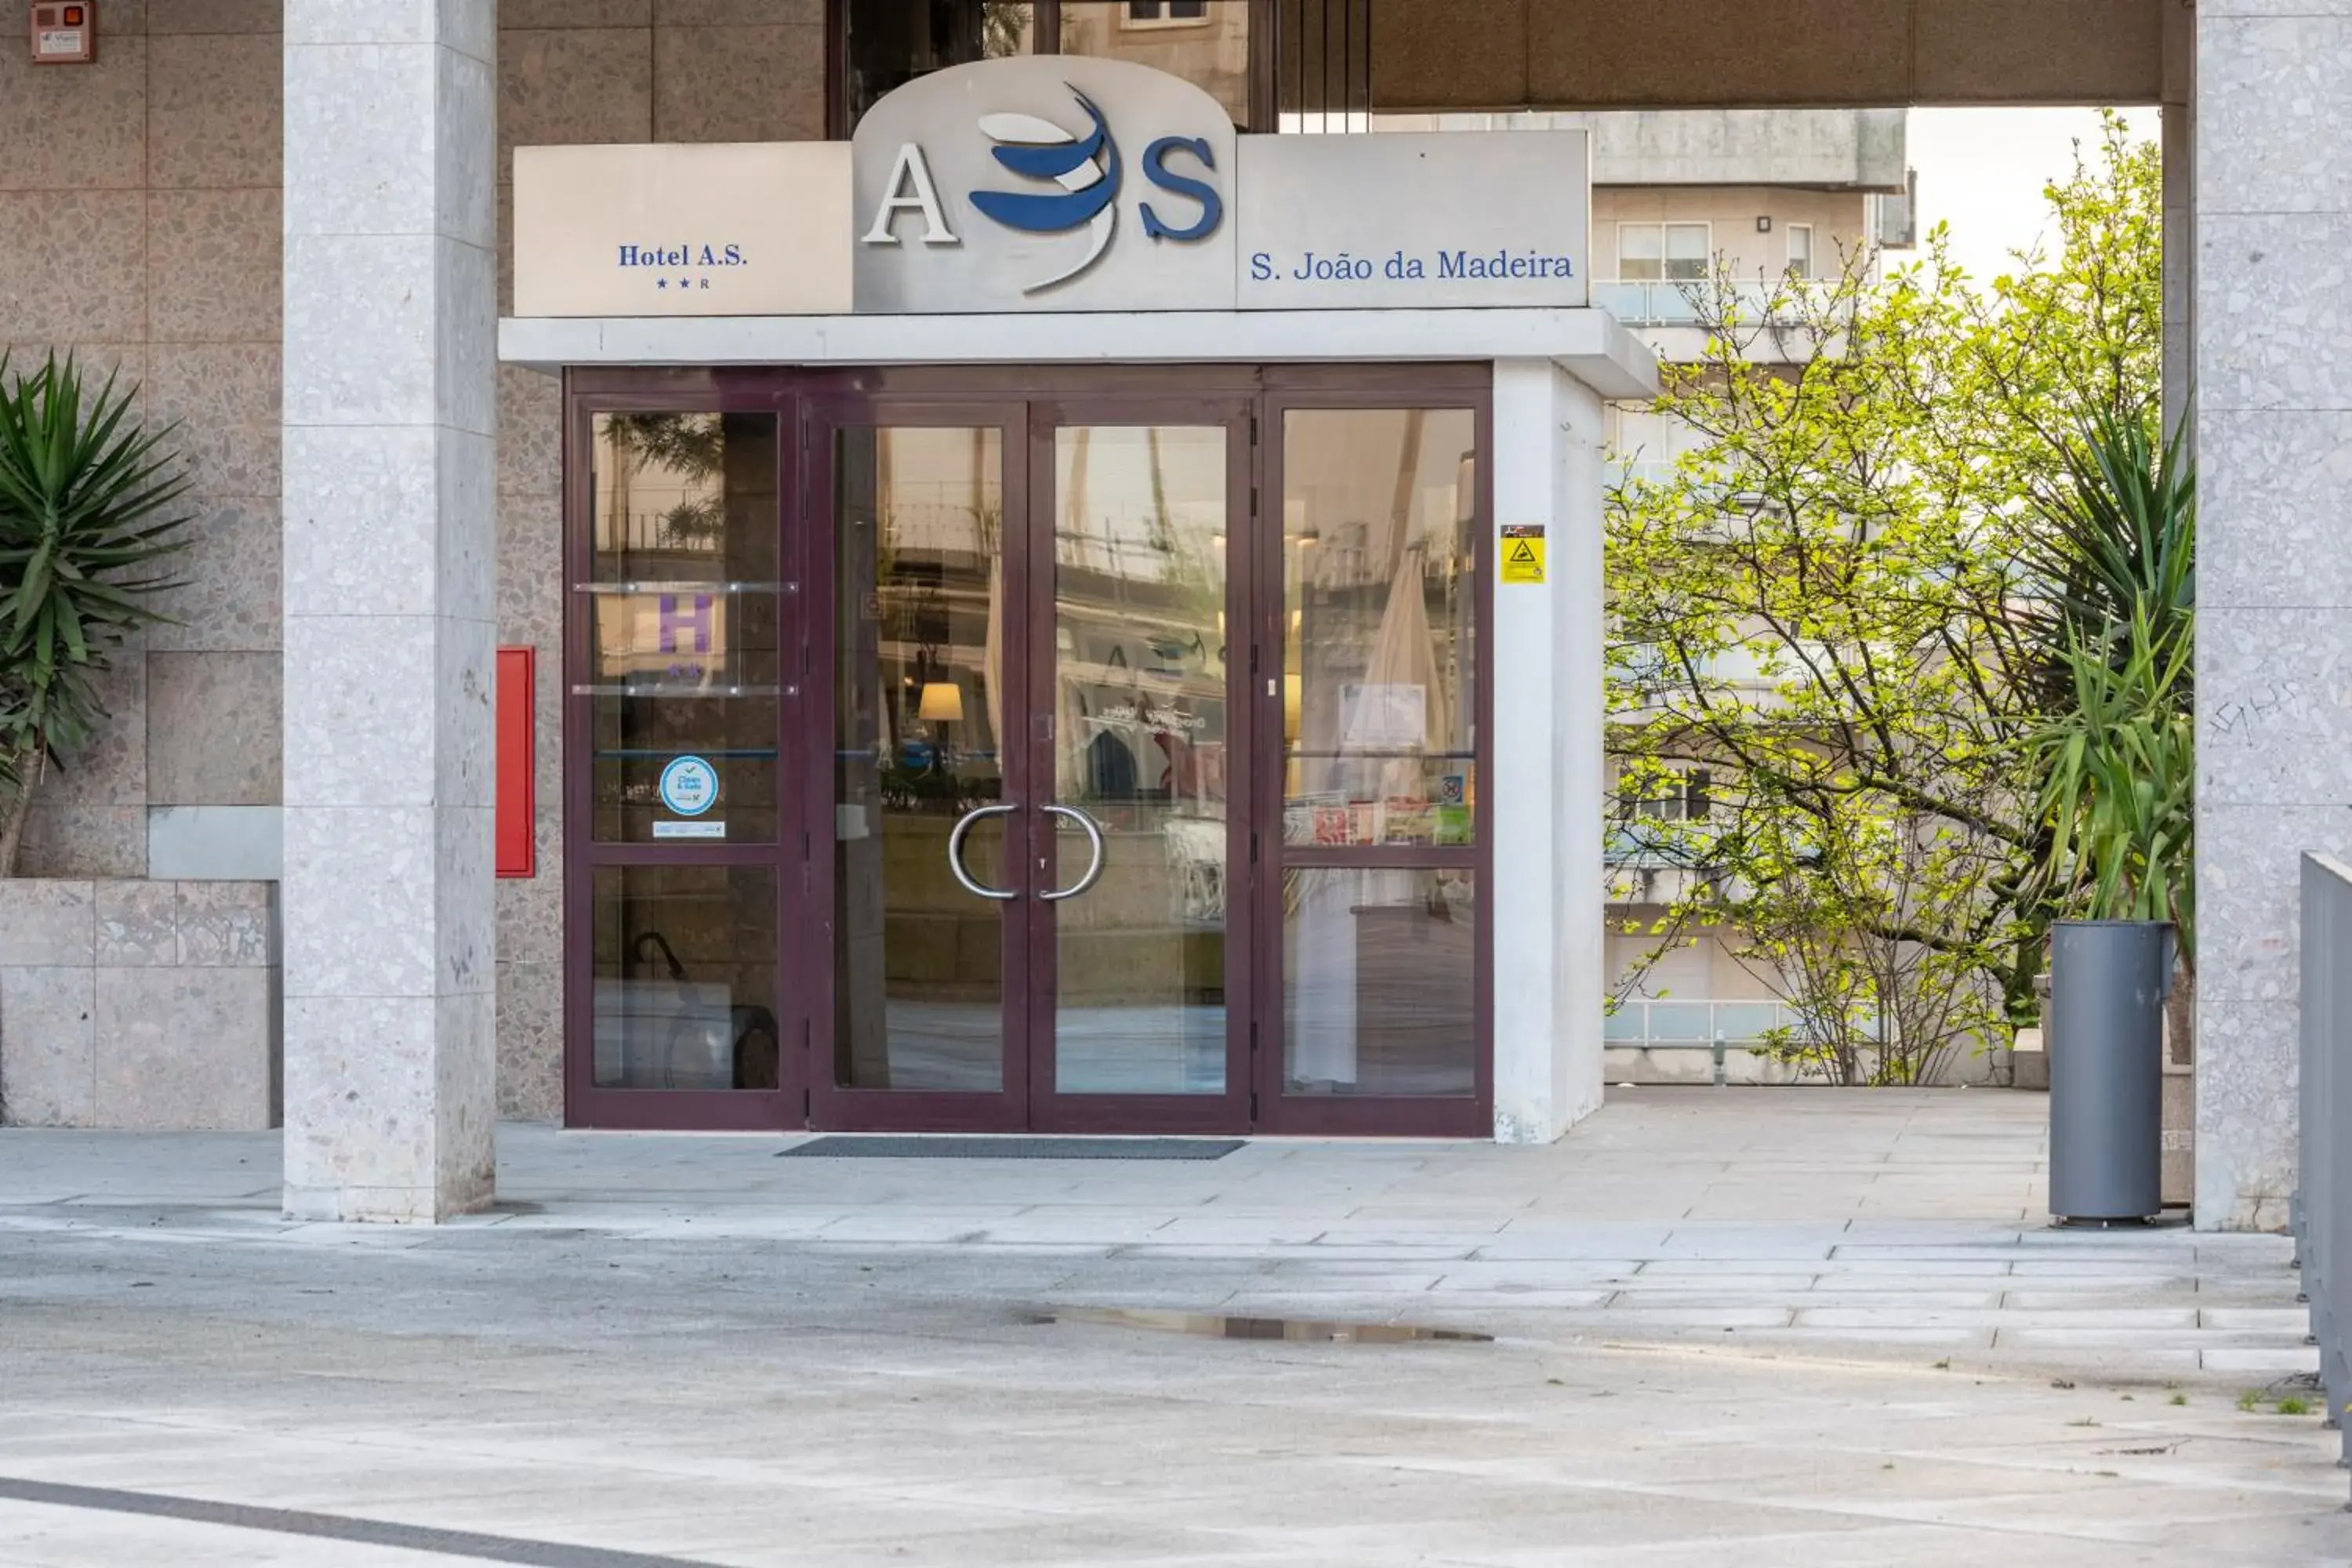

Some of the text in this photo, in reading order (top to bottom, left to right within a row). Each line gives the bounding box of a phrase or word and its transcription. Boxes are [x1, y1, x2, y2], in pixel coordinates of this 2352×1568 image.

[861, 136, 1224, 245] A S
[619, 245, 748, 267] Hotel A.S.
[1251, 249, 1573, 281] S. João da Madeira
[699, 279, 710, 289] R
[659, 593, 713, 653] H
